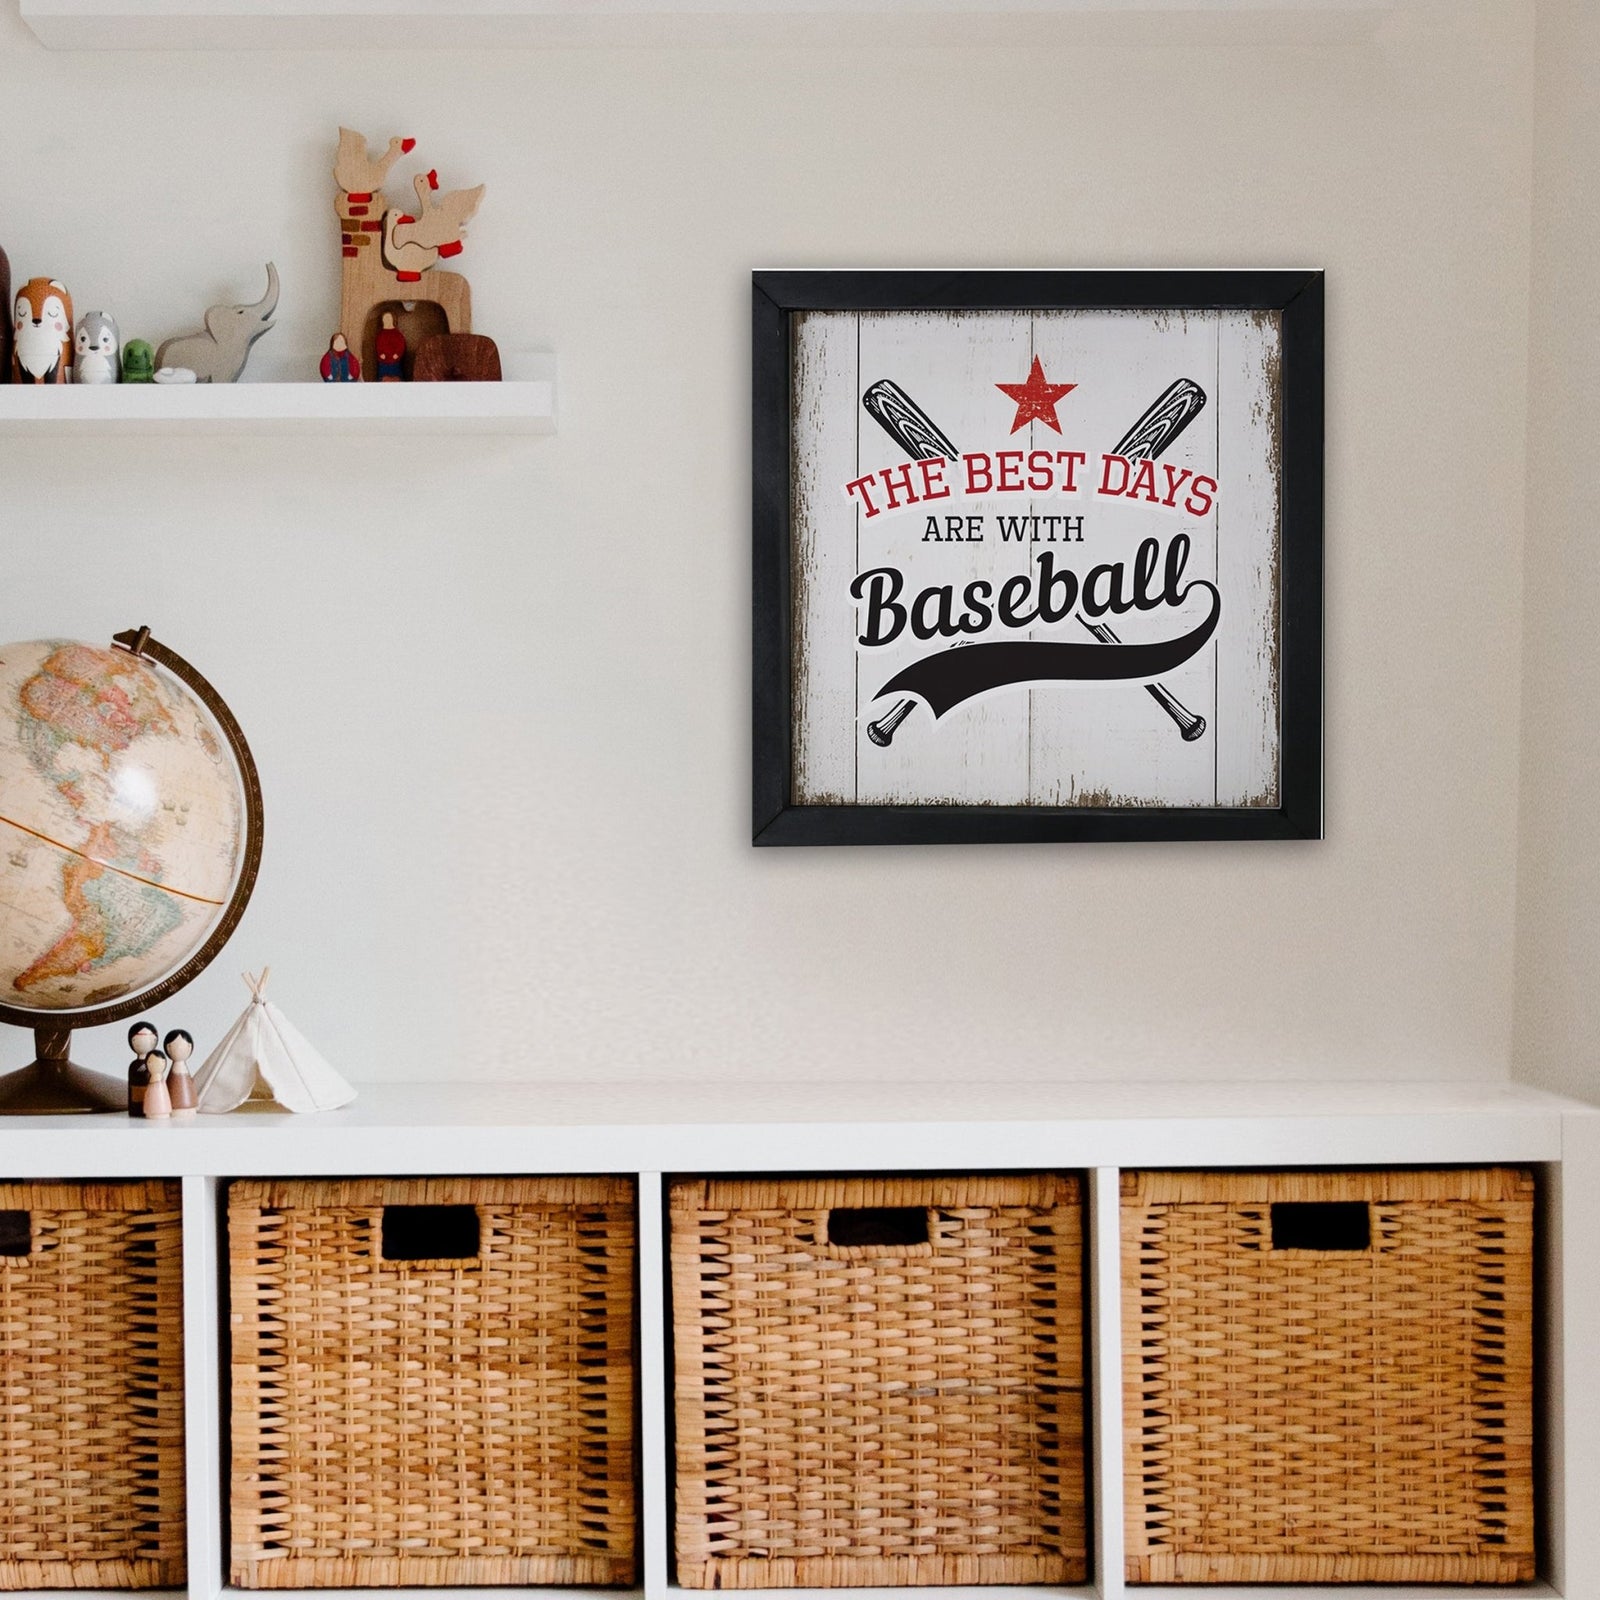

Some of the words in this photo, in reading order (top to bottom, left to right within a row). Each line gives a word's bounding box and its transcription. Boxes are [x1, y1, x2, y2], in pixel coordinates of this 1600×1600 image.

[847, 457, 951, 518] THE
[964, 451, 1085, 493] BEST
[1099, 454, 1218, 517] DAYS
[922, 516, 984, 542] ARE
[997, 516, 1085, 542] WITH
[850, 533, 1192, 647] Baseball
